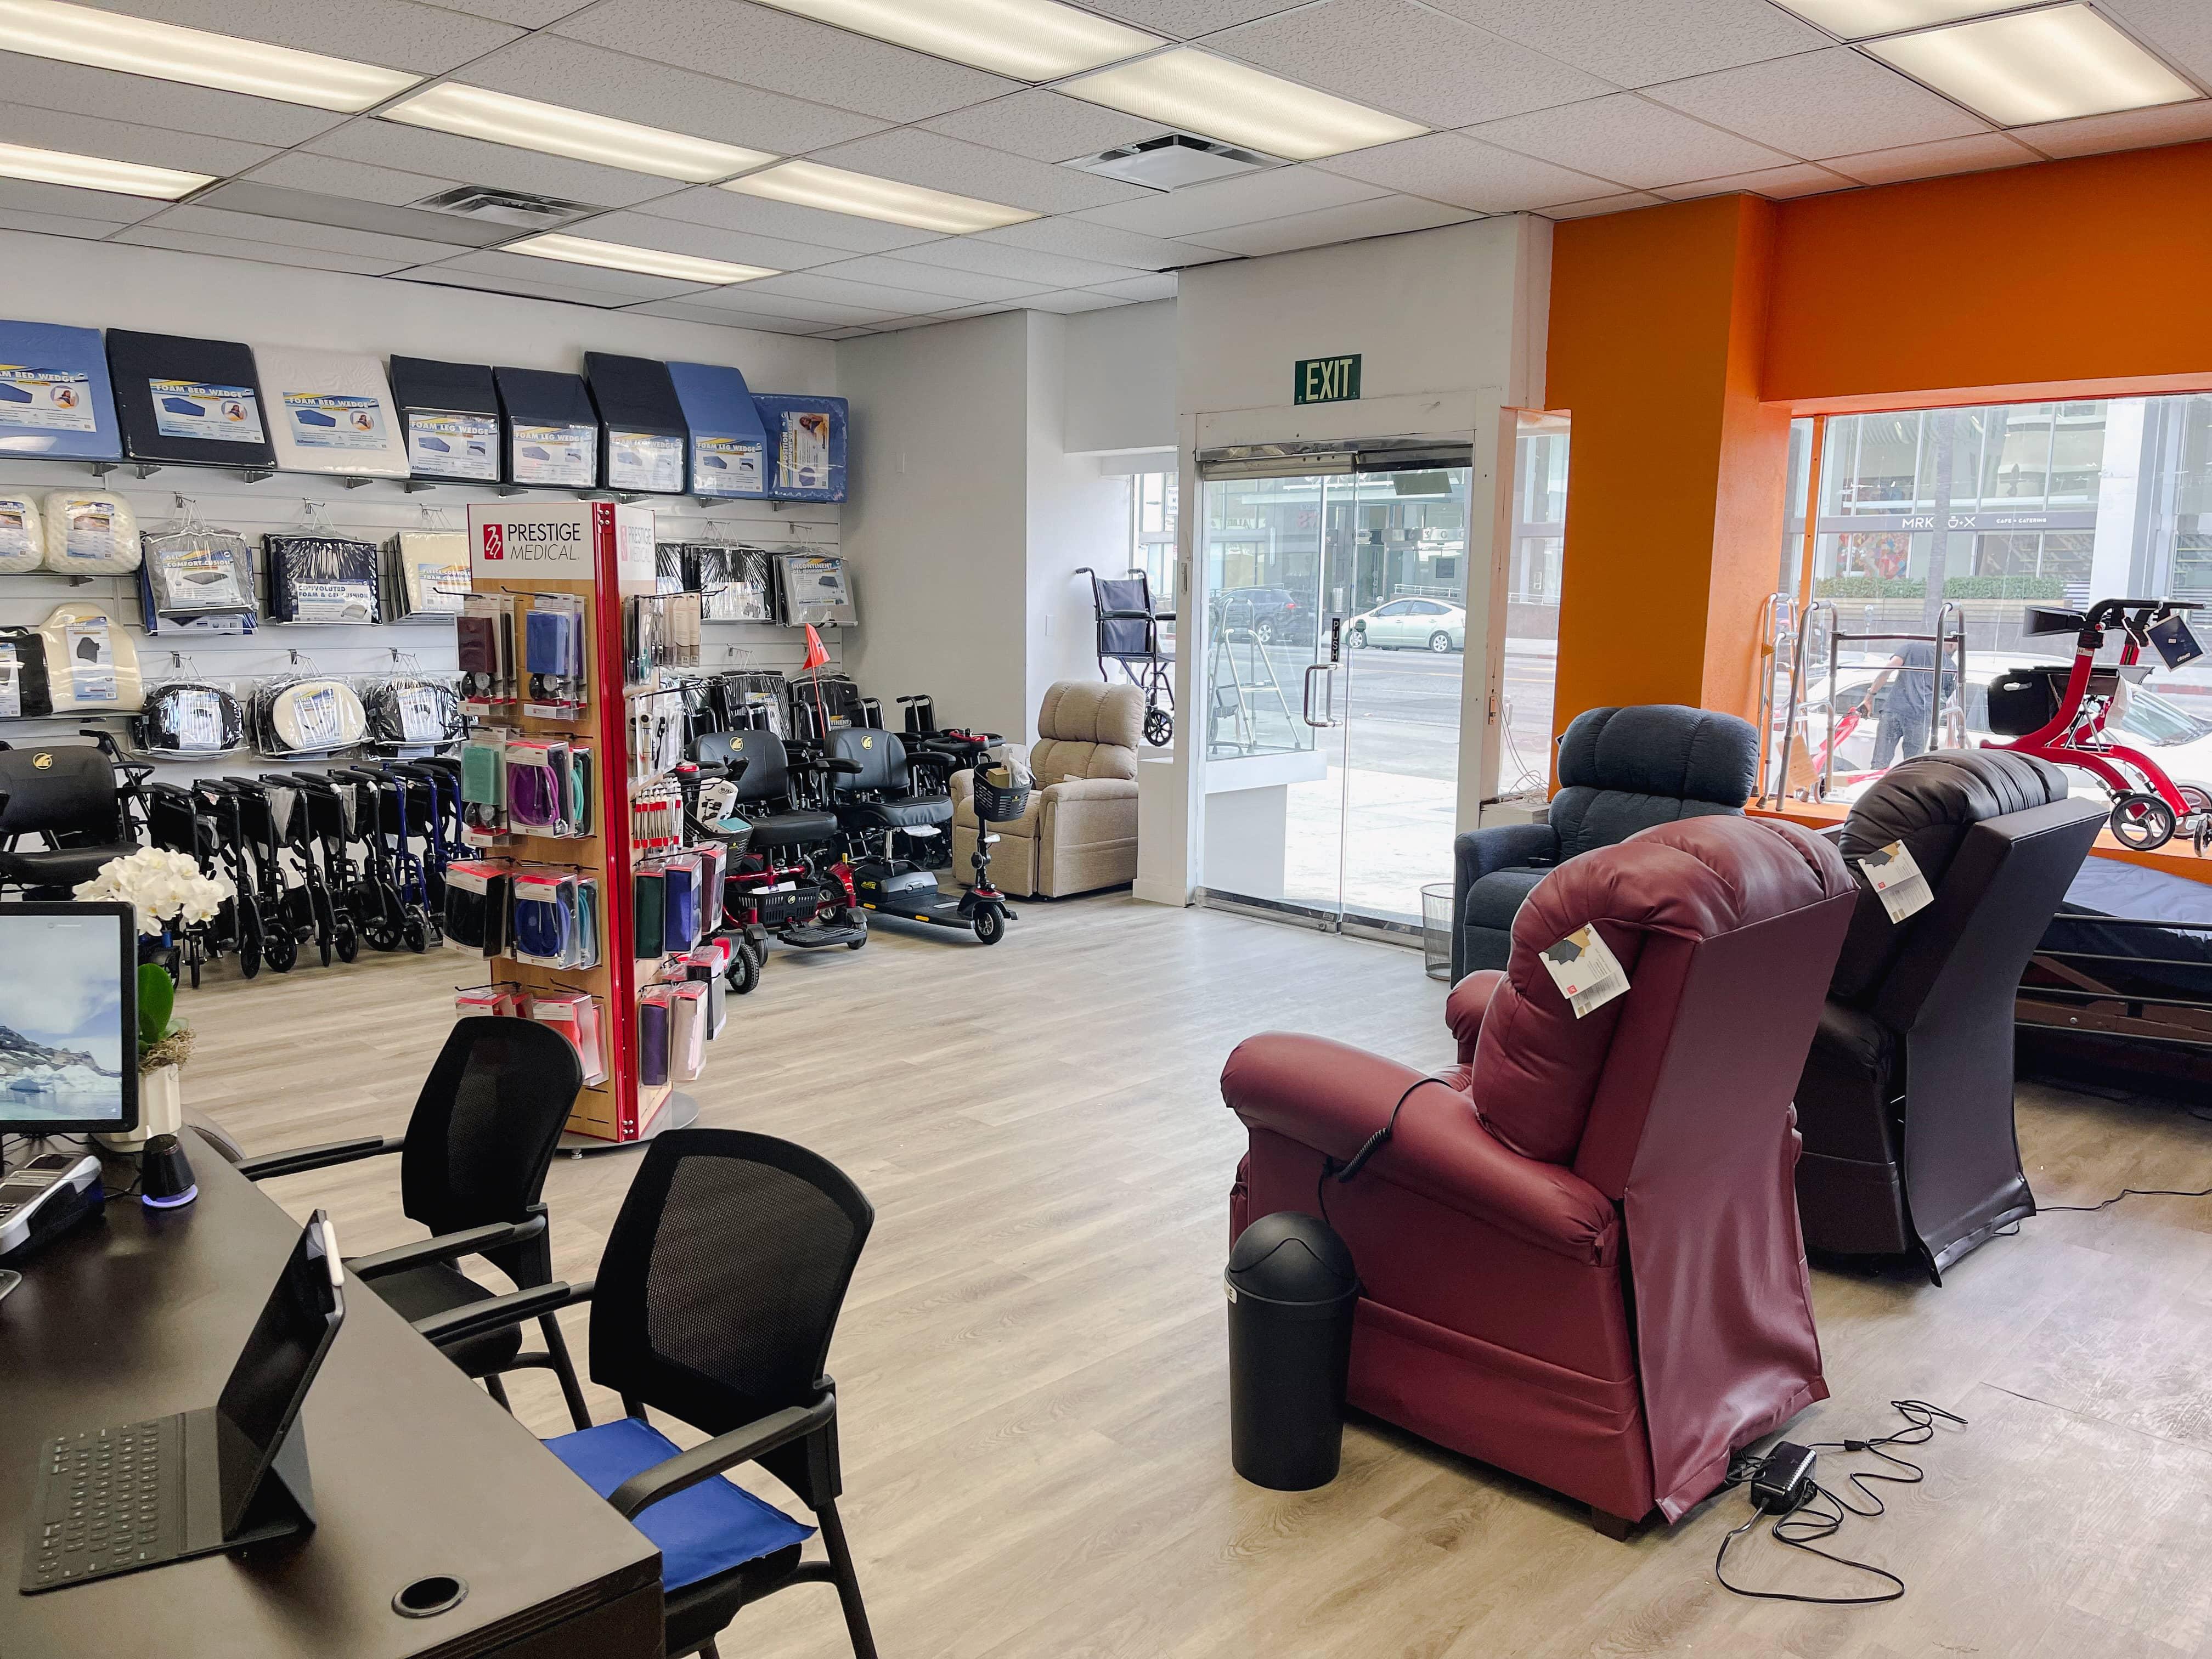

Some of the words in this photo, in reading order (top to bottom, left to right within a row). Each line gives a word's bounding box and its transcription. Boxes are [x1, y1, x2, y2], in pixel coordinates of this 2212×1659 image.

[38, 373, 75, 383] WEDGE
[1306, 358, 1353, 401] EXIT
[155, 385, 185, 393] FOAM
[208, 389, 242, 398] WEDGE
[337, 400, 369, 409] WEDGE
[411, 421, 437, 430] FOAM
[459, 426, 489, 435] WEDGE
[516, 432, 539, 440] FOAM
[557, 433, 584, 443] WEDGE
[507, 523, 581, 541] PRESTIGE
[628, 526, 652, 545] PRESTIGE
[510, 544, 578, 560] MEDICAL
